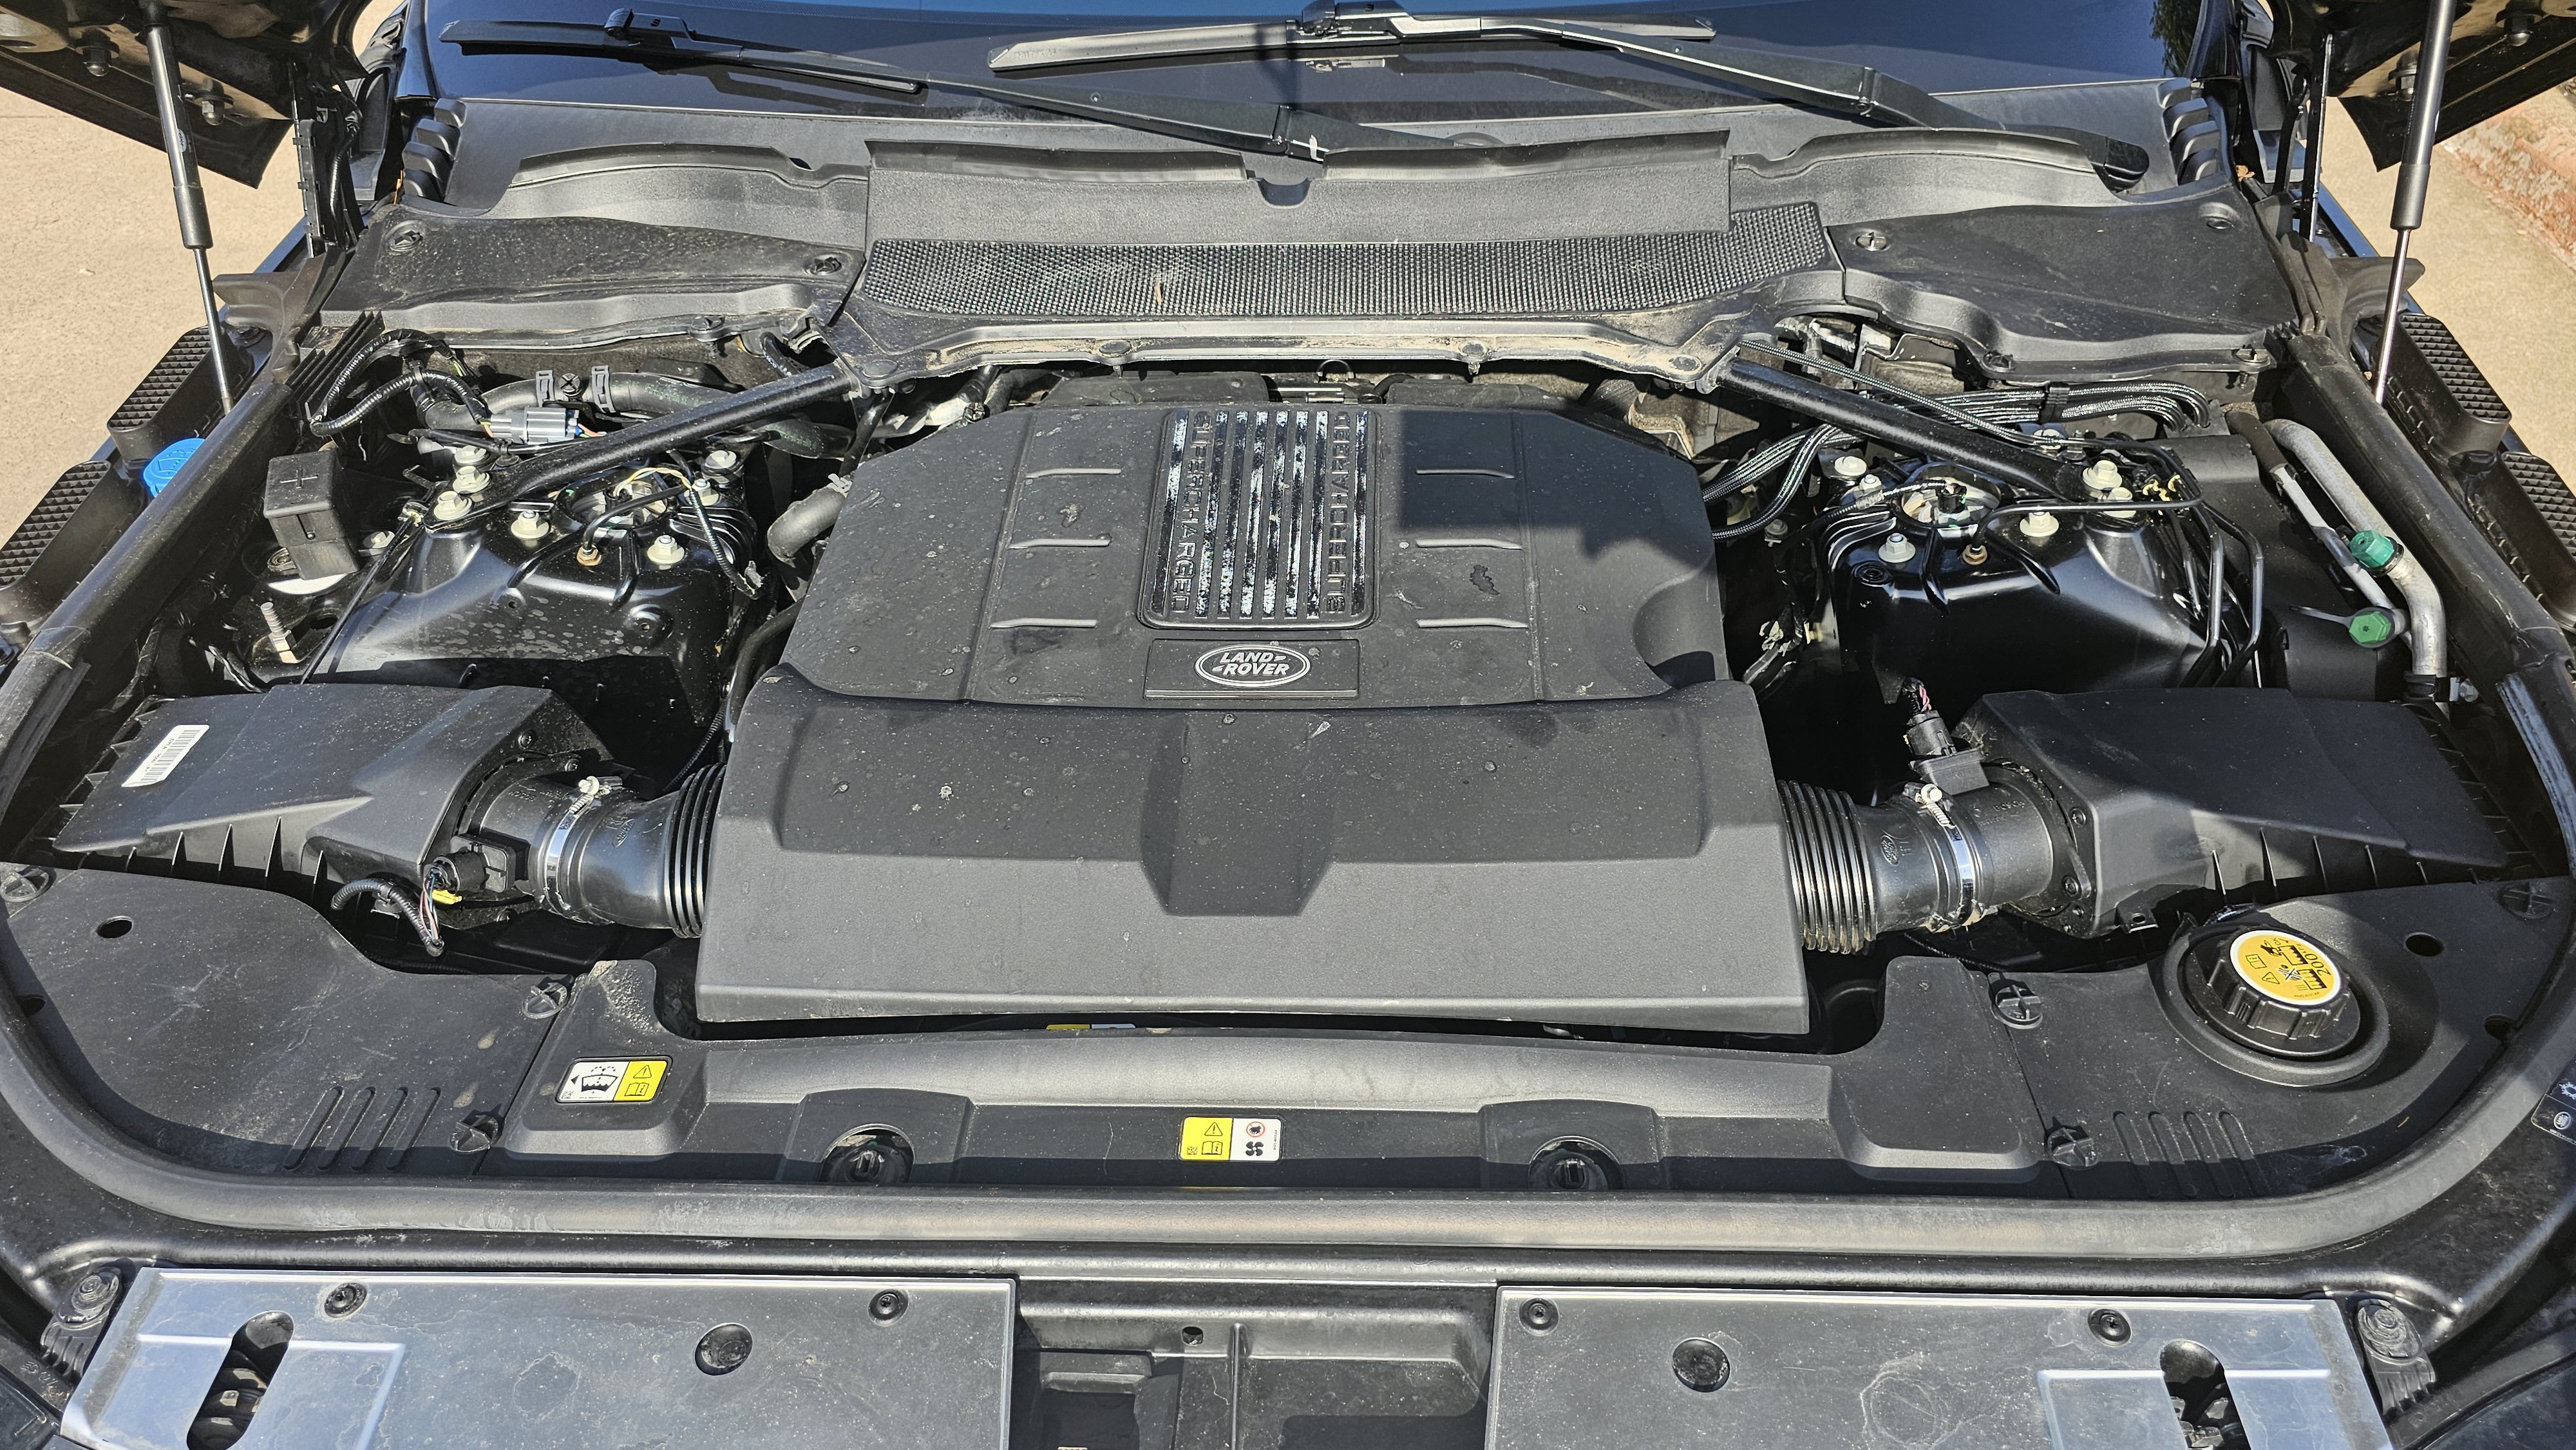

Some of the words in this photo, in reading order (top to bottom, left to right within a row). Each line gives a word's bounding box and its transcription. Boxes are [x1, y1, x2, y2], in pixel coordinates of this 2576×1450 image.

[1171, 410, 1212, 614] SUPERCHARGED
[1326, 411, 1351, 613] SUPERCHARGED
[1220, 652, 1274, 663] LAND
[1222, 663, 1290, 676] ROVER
[2305, 953, 2331, 976] 200
